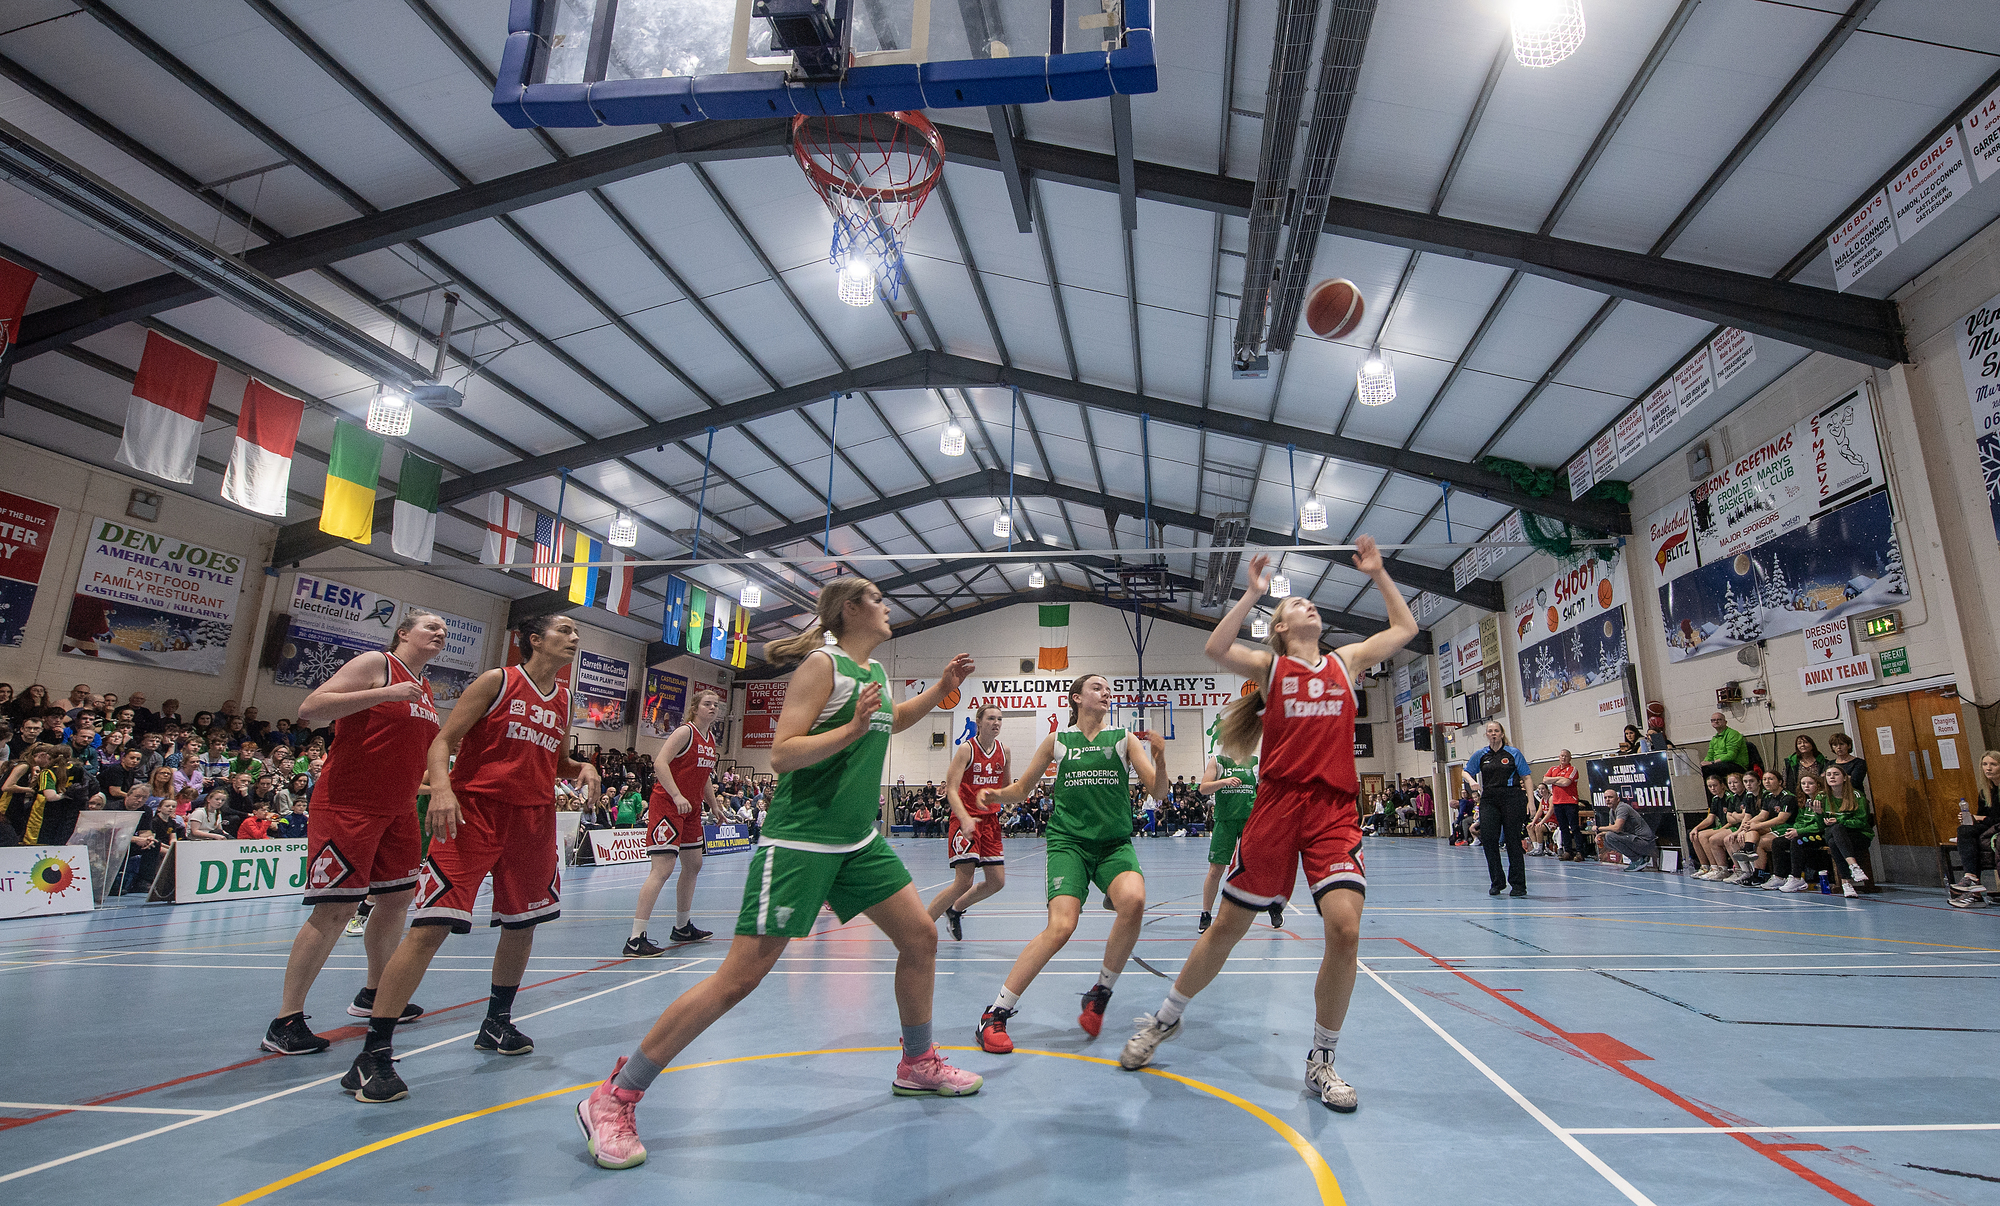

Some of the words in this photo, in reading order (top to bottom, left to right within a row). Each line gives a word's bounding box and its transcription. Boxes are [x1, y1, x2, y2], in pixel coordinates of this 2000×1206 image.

[1970, 115, 1978, 128] U
[1982, 100, 1996, 117] 14
[1894, 167, 1918, 193] U-16
[1920, 136, 1953, 171] GIRLS
[1908, 168, 1937, 195] SPONSORED
[1938, 161, 1944, 170] BY
[1896, 197, 1920, 219] EAMON,
[1920, 187, 1931, 200] LIZ
[1930, 159, 1963, 191] O'CONNOR
[1915, 191, 1953, 223] CASTLEISLAND
[1916, 186, 1949, 214] CASTLEVIEW,
[1832, 223, 1853, 244] U-16
[1853, 196, 1882, 226] BOY'S
[1844, 225, 1868, 247] SPONSORED
[1868, 231, 1885, 247] HEATING
[1834, 247, 1855, 267] NIALL
[1851, 250, 1883, 278] CASTLEISLAND
[1713, 334, 1725, 347] MOST
[1715, 337, 1730, 353] YOUNG
[1684, 365, 1694, 375] LOCAL
[1694, 351, 1707, 367] PLAYER
[1724, 356, 1742, 372] TREASURE
[1742, 346, 1753, 359] CHEST
[1680, 393, 1692, 405] ALLIED
[1700, 377, 1711, 389] BANK
[1617, 428, 1626, 439] THE
[1626, 415, 1642, 433] FUTURE
[1619, 415, 1632, 429] STARS
[1695, 470, 1730, 504] SEASONS
[1735, 431, 1793, 477] GREETINGS
[1718, 487, 1740, 504] FROM
[1743, 475, 1755, 490] ST.
[1757, 455, 1791, 480] MARYS
[1719, 480, 1769, 515] BASKETBALL
[1770, 466, 1794, 486] CLUB
[9, 510, 24, 520] THE
[25, 514, 46, 526] BLITZ
[1650, 507, 1689, 541] Basketball
[1720, 531, 1741, 548] MAJOR
[1743, 512, 1780, 536] SPONSORS
[97, 522, 165, 555] DEN
[168, 543, 240, 573] JOES
[1666, 541, 1690, 563] BLITZ
[96, 544, 183, 574] AMERICAN
[187, 567, 234, 586] STYLE
[127, 566, 162, 583] FAST
[163, 576, 200, 592] FOOD
[1555, 559, 1595, 605] SHOOT
[93, 571, 145, 592] FAMILY
[146, 584, 225, 609] RESTURANT
[296, 577, 365, 610] FLESK
[84, 584, 164, 607] CASTLEISLAND
[173, 603, 229, 620] KILLARNEY
[293, 598, 344, 620] Electrical
[345, 610, 360, 622] Ltd
[1563, 597, 1585, 622] SHOOT
[326, 622, 347, 633] Industrial
[347, 627, 367, 637] Electrical
[1805, 619, 1847, 639] DRESSING
[1812, 634, 1843, 650] ROOMS
[441, 655, 478, 669] Community
[1880, 651, 1892, 661] FIRE
[1892, 649, 1904, 659] EXIT
[582, 658, 603, 670] Garreth
[603, 663, 627, 677] McCarthy
[1805, 667, 1833, 686] AWAY
[1836, 661, 1869, 679] TEAM
[581, 672, 599, 682] FARRAN
[599, 675, 613, 685] PLANT
[660, 675, 687, 686] CASTLEISLAND
[660, 684, 683, 693] COMMUNITY
[982, 680, 1073, 693] WELCOME
[1308, 678, 1324, 699] 8
[590, 687, 614, 696] CASTLEISLAND
[659, 692, 676, 701] COLLEGE
[968, 696, 1047, 709] ANNUAL
[1179, 693, 1231, 706] BLITZ
[529, 704, 556, 728] 30
[1283, 698, 1344, 719] KENMARE
[1599, 701, 1613, 712] HOME
[1933, 716, 1955, 726] Changing
[1938, 725, 1954, 733] Rooms
[506, 721, 561, 753] KENMARE
[1068, 748, 1081, 760] 12
[985, 763, 993, 774] 4
[1224, 768, 1232, 776] 15
[1608, 774, 1634, 784] BASKETBALL
[1633, 773, 1646, 782] CLUB
[1619, 764, 1636, 773] MARY'S
[973, 775, 999, 785] KENMARE
[1064, 778, 1119, 787] CONSTRUCTION
[1636, 787, 1671, 807] BLITZ
[657, 825, 668, 842] K
[707, 840, 725, 848] HEATING
[730, 838, 749, 846] PLUMBING
[240, 844, 282, 854] MAJOR
[196, 857, 280, 895] DEN
[312, 858, 333, 884] K
